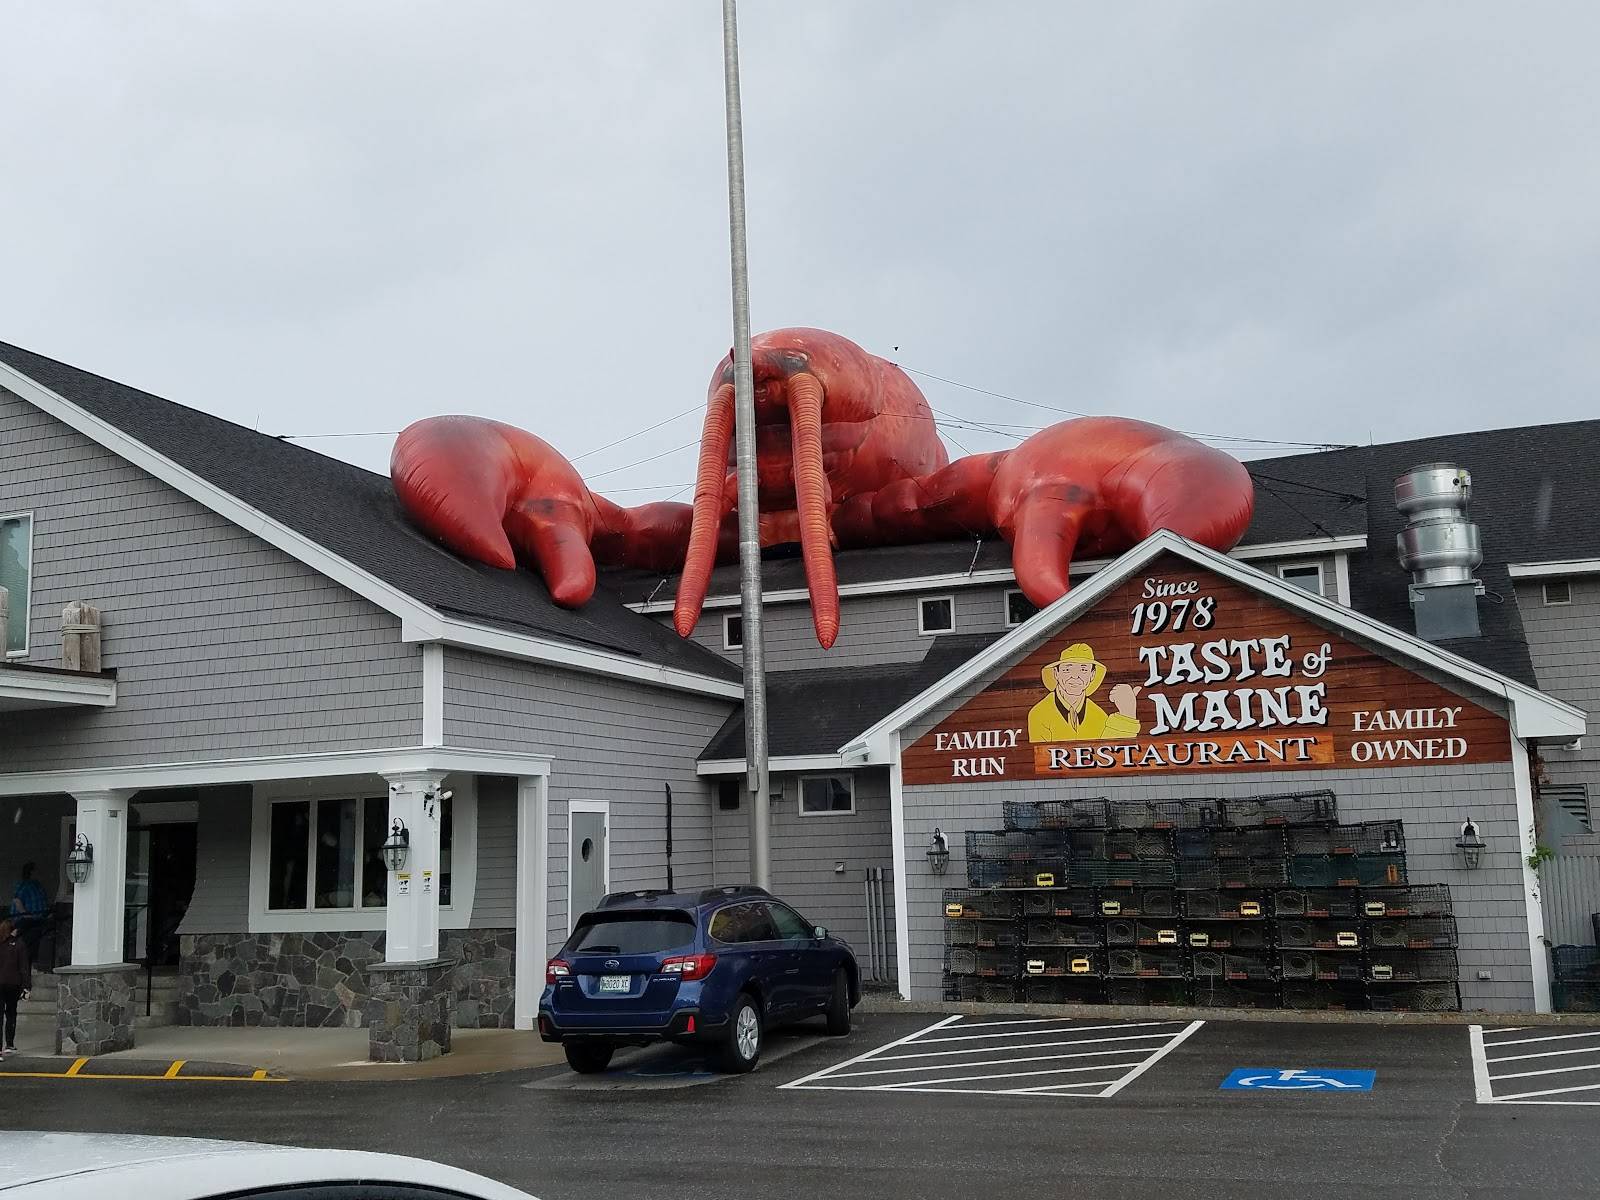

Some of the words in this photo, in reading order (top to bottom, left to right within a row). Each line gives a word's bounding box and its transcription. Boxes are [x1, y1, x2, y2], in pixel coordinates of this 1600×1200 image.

[1141, 577, 1199, 600] Since
[1131, 595, 1216, 635] 1978
[1139, 634, 1292, 687] TASTE
[1301, 642, 1333, 678] of
[1149, 682, 1328, 736] MAINE
[1352, 706, 1462, 732] FAMILY
[934, 728, 1022, 751] FAMILY
[1048, 737, 1317, 768] RESTAURANT
[1350, 737, 1467, 762] OWNED
[952, 756, 1006, 777] RUN
